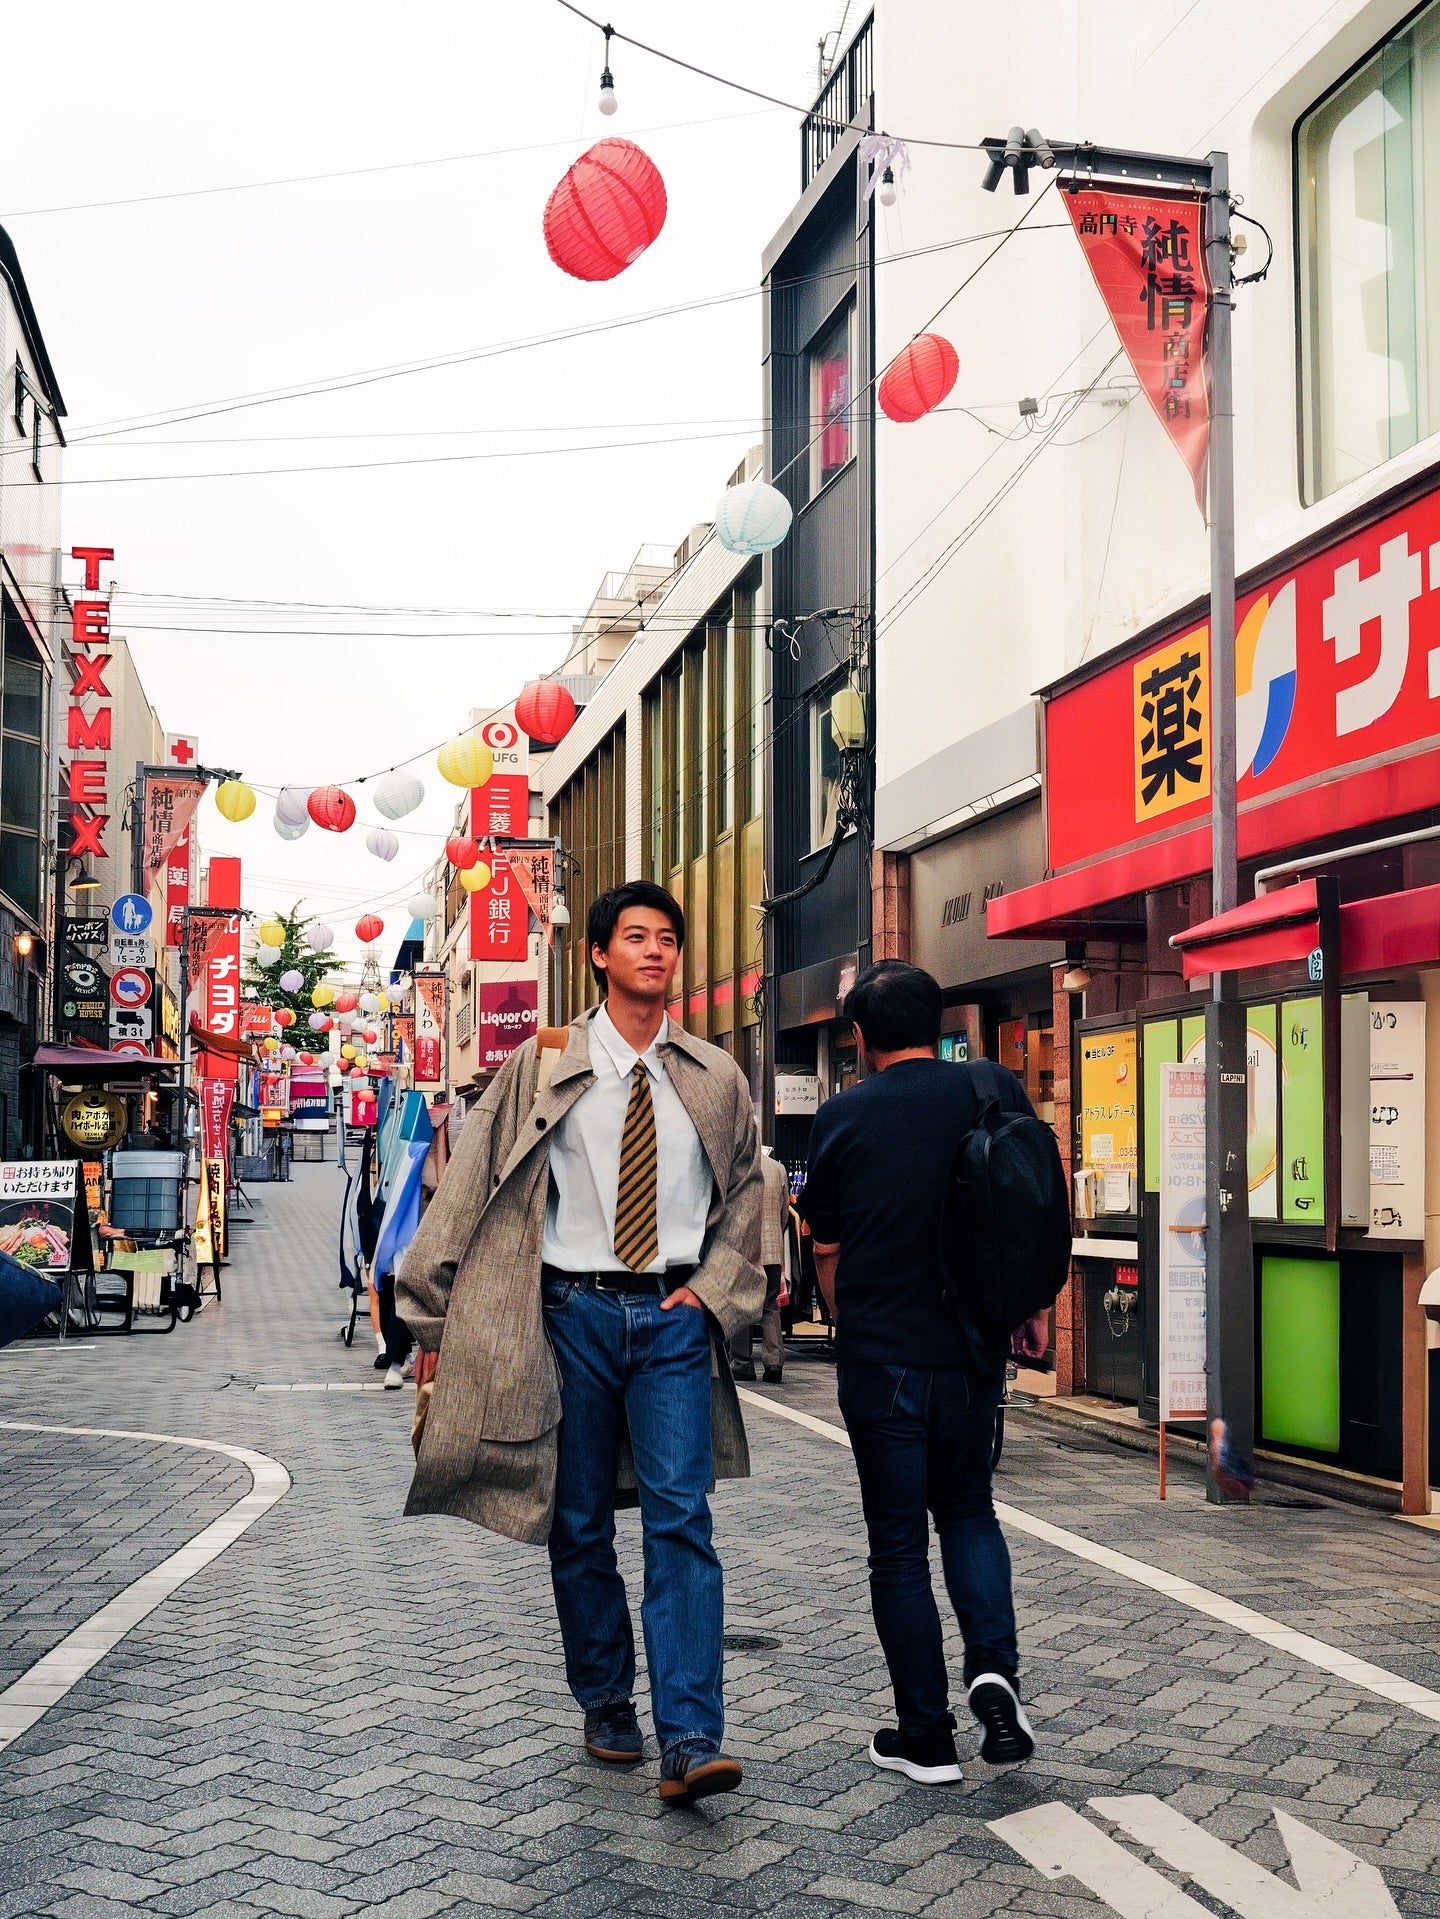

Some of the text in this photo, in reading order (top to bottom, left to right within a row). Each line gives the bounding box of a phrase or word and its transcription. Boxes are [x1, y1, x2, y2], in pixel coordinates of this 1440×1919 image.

[1129, 204, 1163, 214] Shopping
[1079, 212, 1137, 236] 高円寺
[1140, 215, 1197, 421] 純情商店街
[1141, 651, 1203, 806] 薬
[491, 753, 519, 763] UFG
[175, 788, 200, 798] 高円寺
[150, 787, 174, 869] 純情商店街
[480, 1011, 520, 1027] Liquor
[17, 1167, 74, 1179] お持ち帰り
[4, 1181, 73, 1193] いただけます
